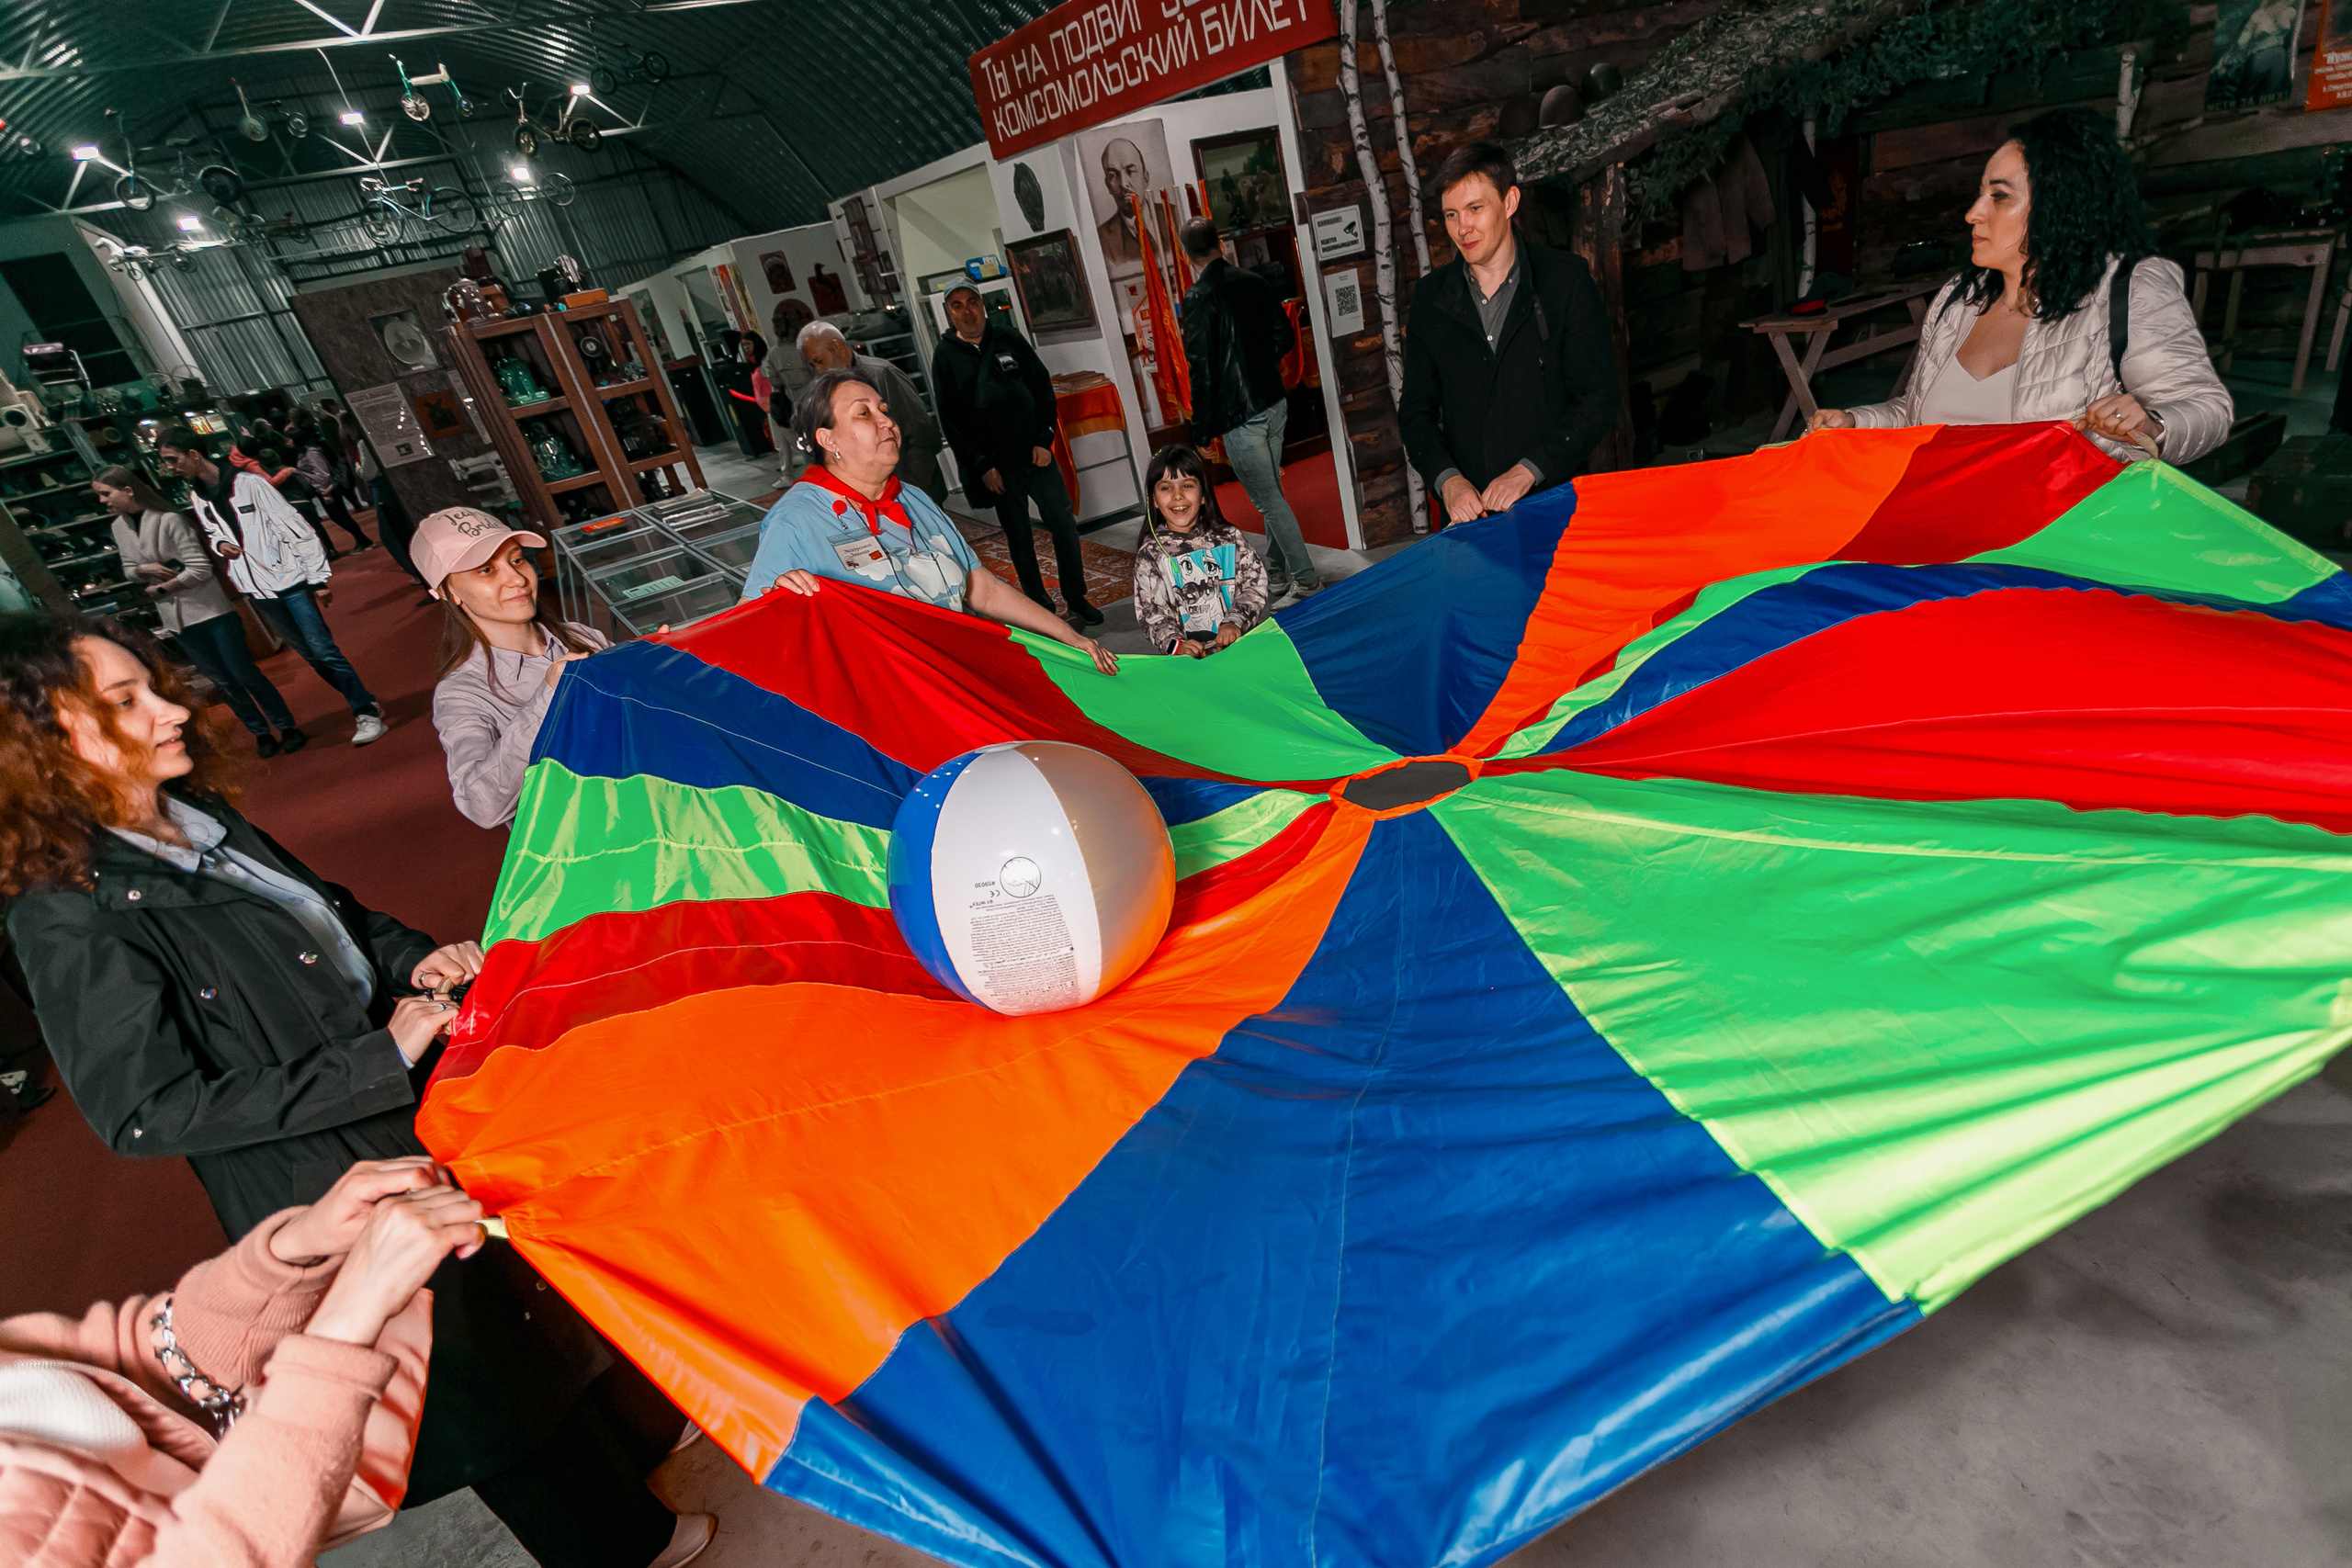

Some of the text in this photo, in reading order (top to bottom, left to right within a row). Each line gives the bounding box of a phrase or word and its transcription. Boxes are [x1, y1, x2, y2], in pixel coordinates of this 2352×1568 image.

[992, 13, 1199, 142] КОМСОМОЛЬСКИЙ
[1012, 43, 1048, 89] НА
[974, 881, 995, 889] #59030
